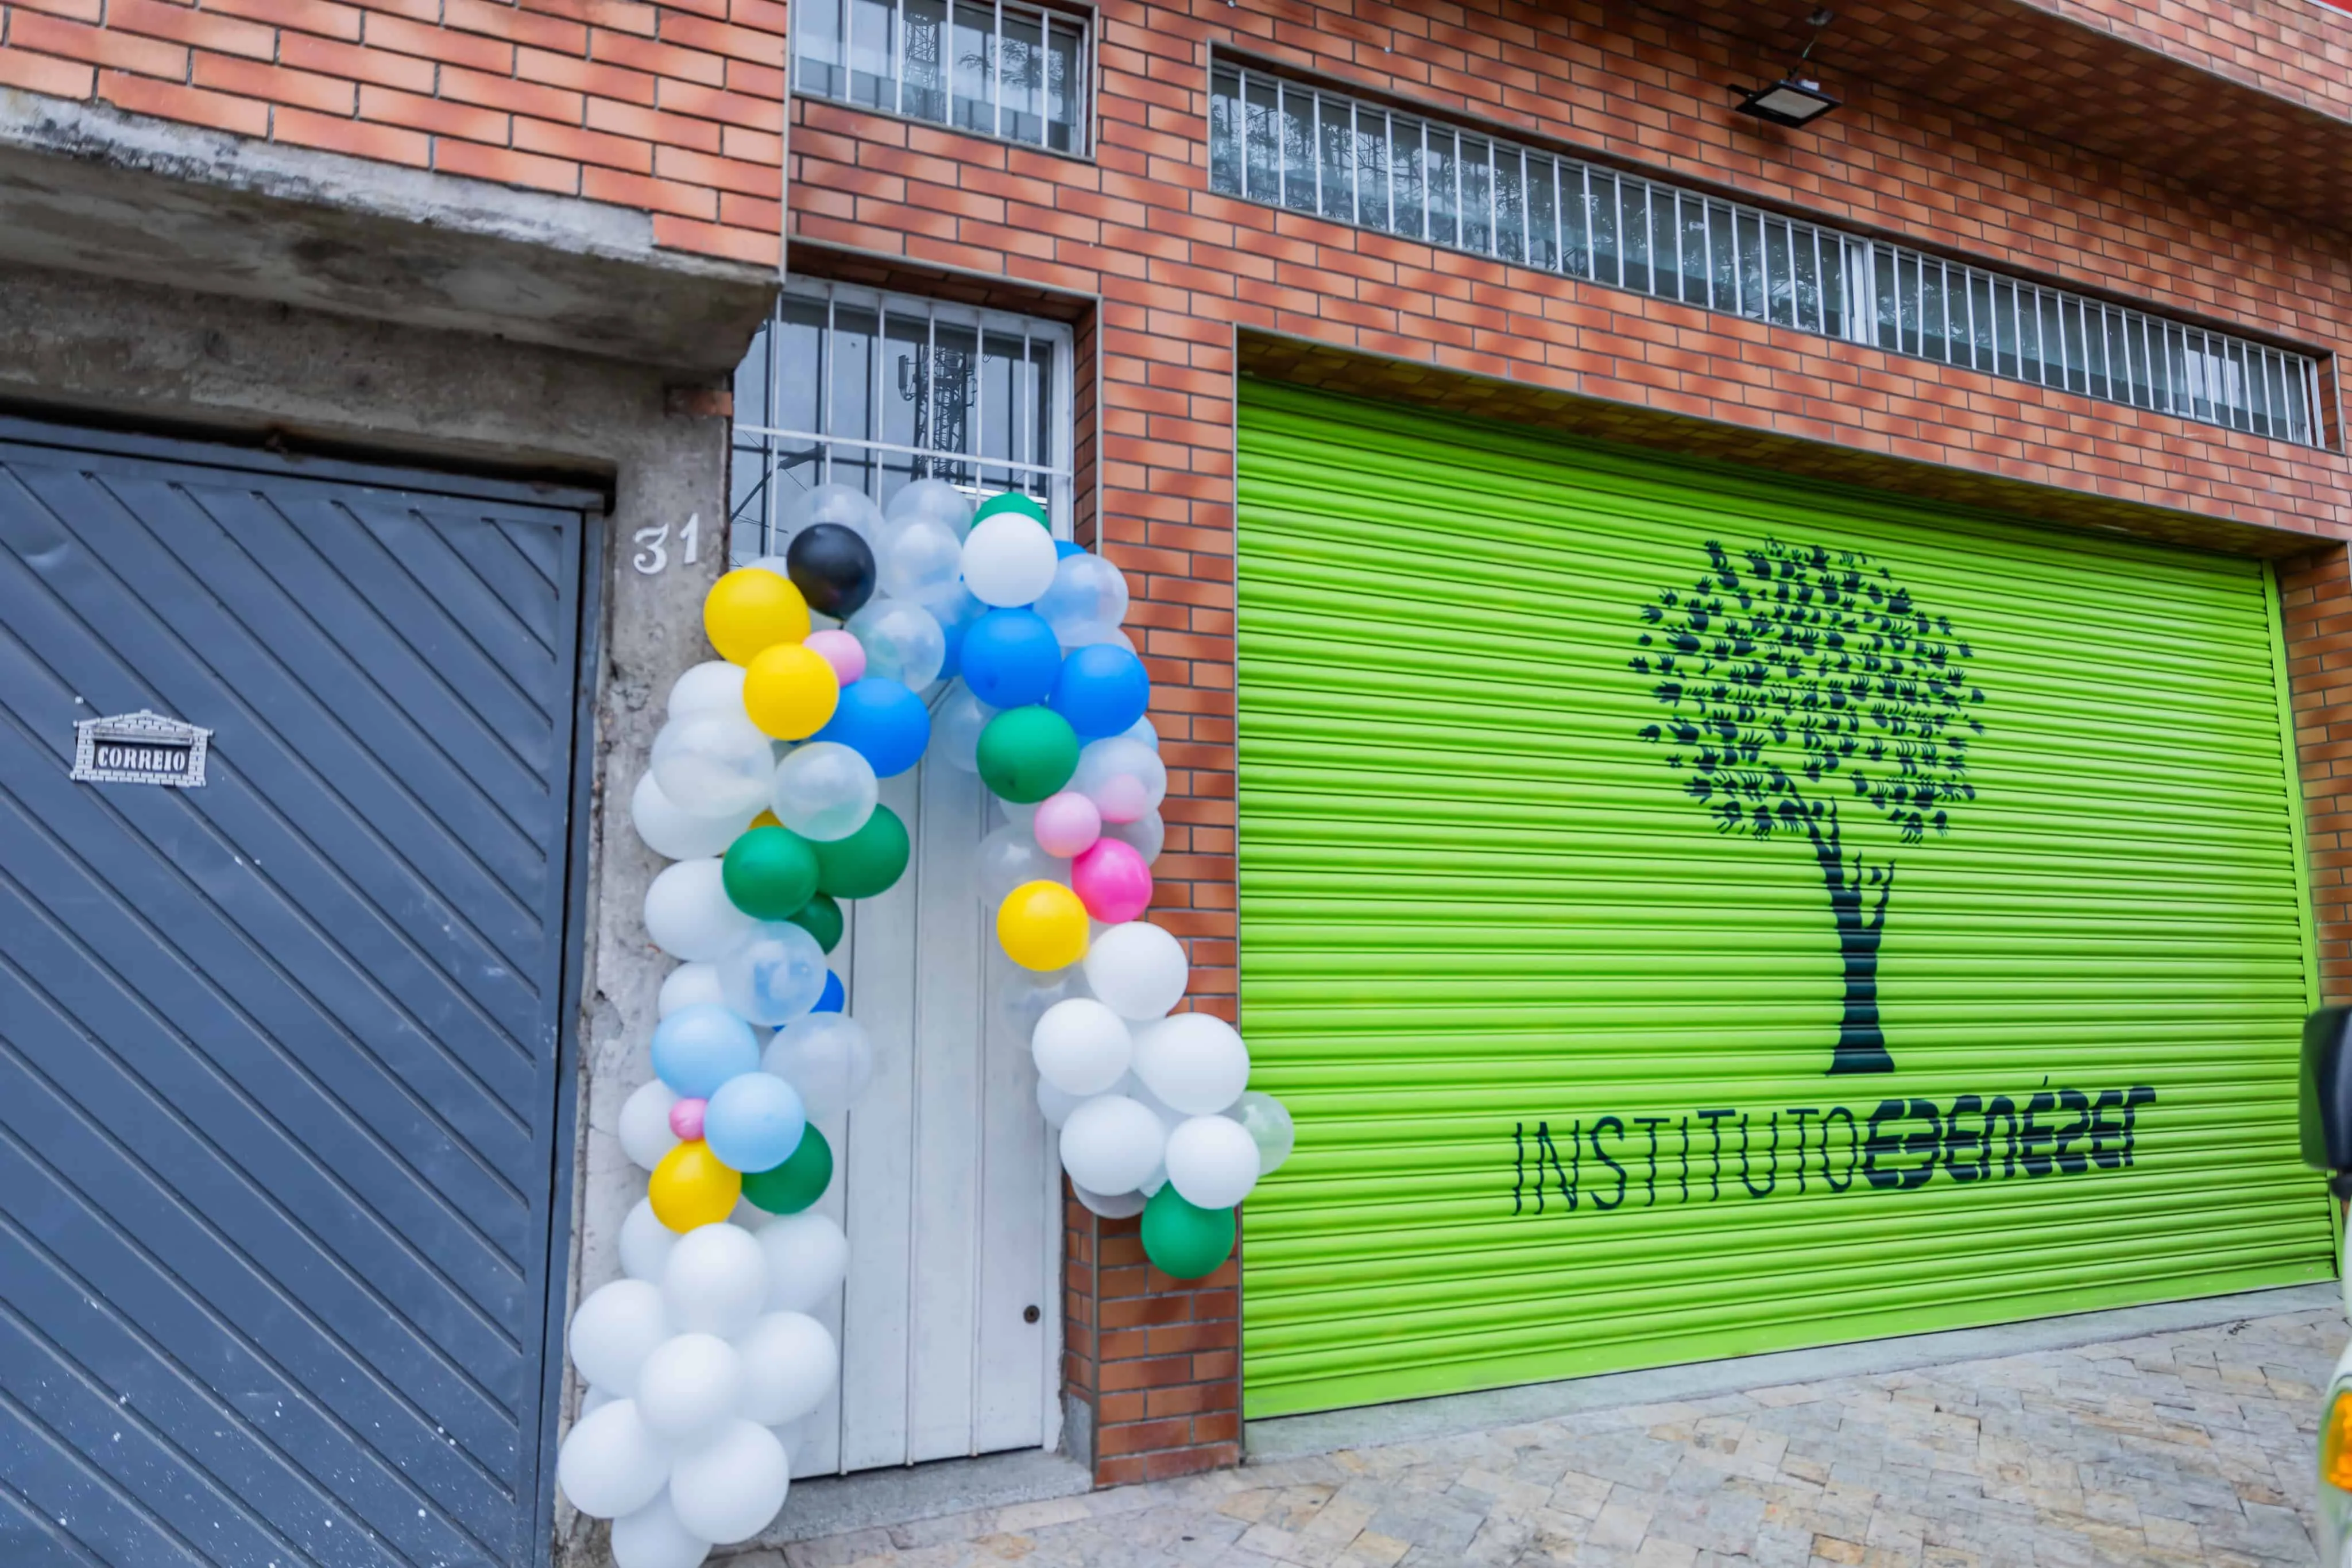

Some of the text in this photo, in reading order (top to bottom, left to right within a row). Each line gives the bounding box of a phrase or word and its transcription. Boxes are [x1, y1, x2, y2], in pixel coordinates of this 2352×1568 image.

[633, 512, 699, 575] 31
[97, 746, 186, 772] CORREIO
[1511, 1106, 1858, 1216] INSTITUTO
